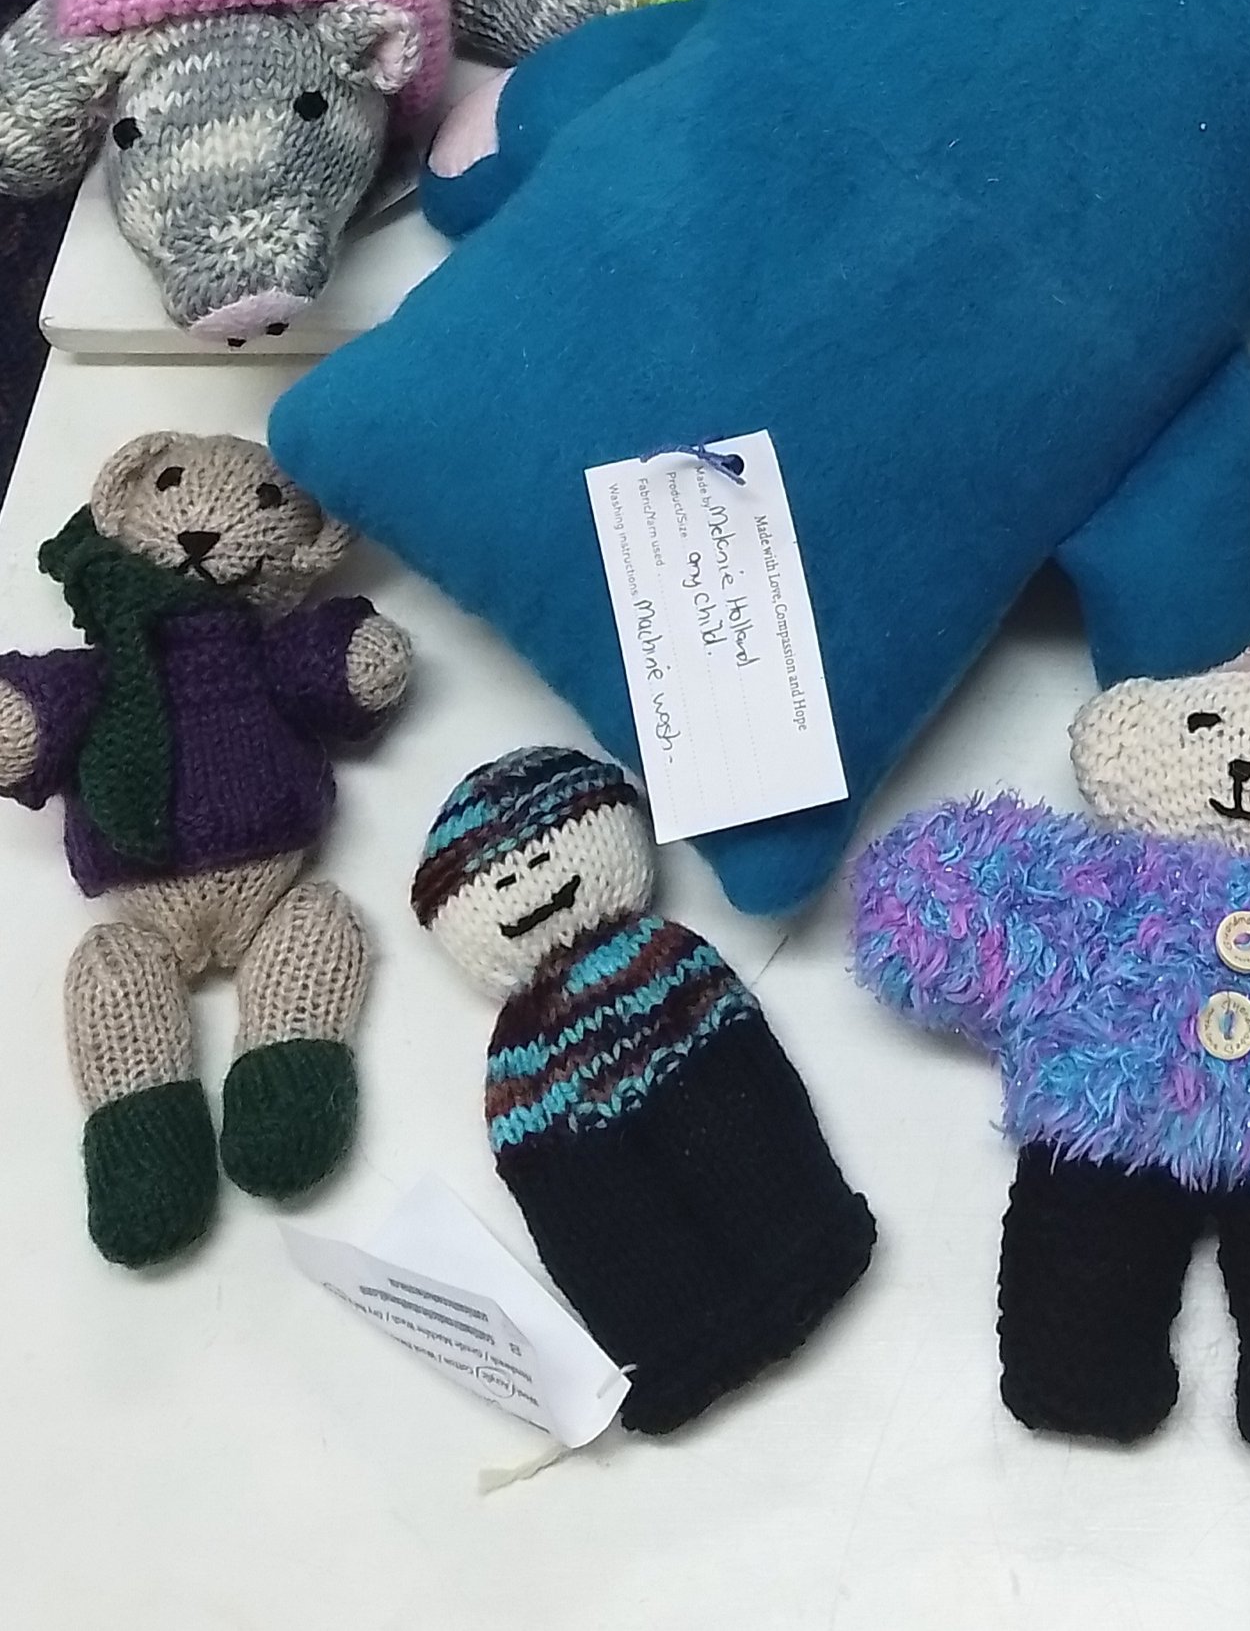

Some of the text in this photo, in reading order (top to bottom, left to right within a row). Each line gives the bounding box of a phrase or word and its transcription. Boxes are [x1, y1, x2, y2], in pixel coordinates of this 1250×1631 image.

[609, 482, 625, 530] Washing
[638, 477, 665, 567] Fabric/Yarn used
[666, 471, 688, 539] Product/Size
[754, 515, 807, 732] Made with Love, Compassion and Hope
